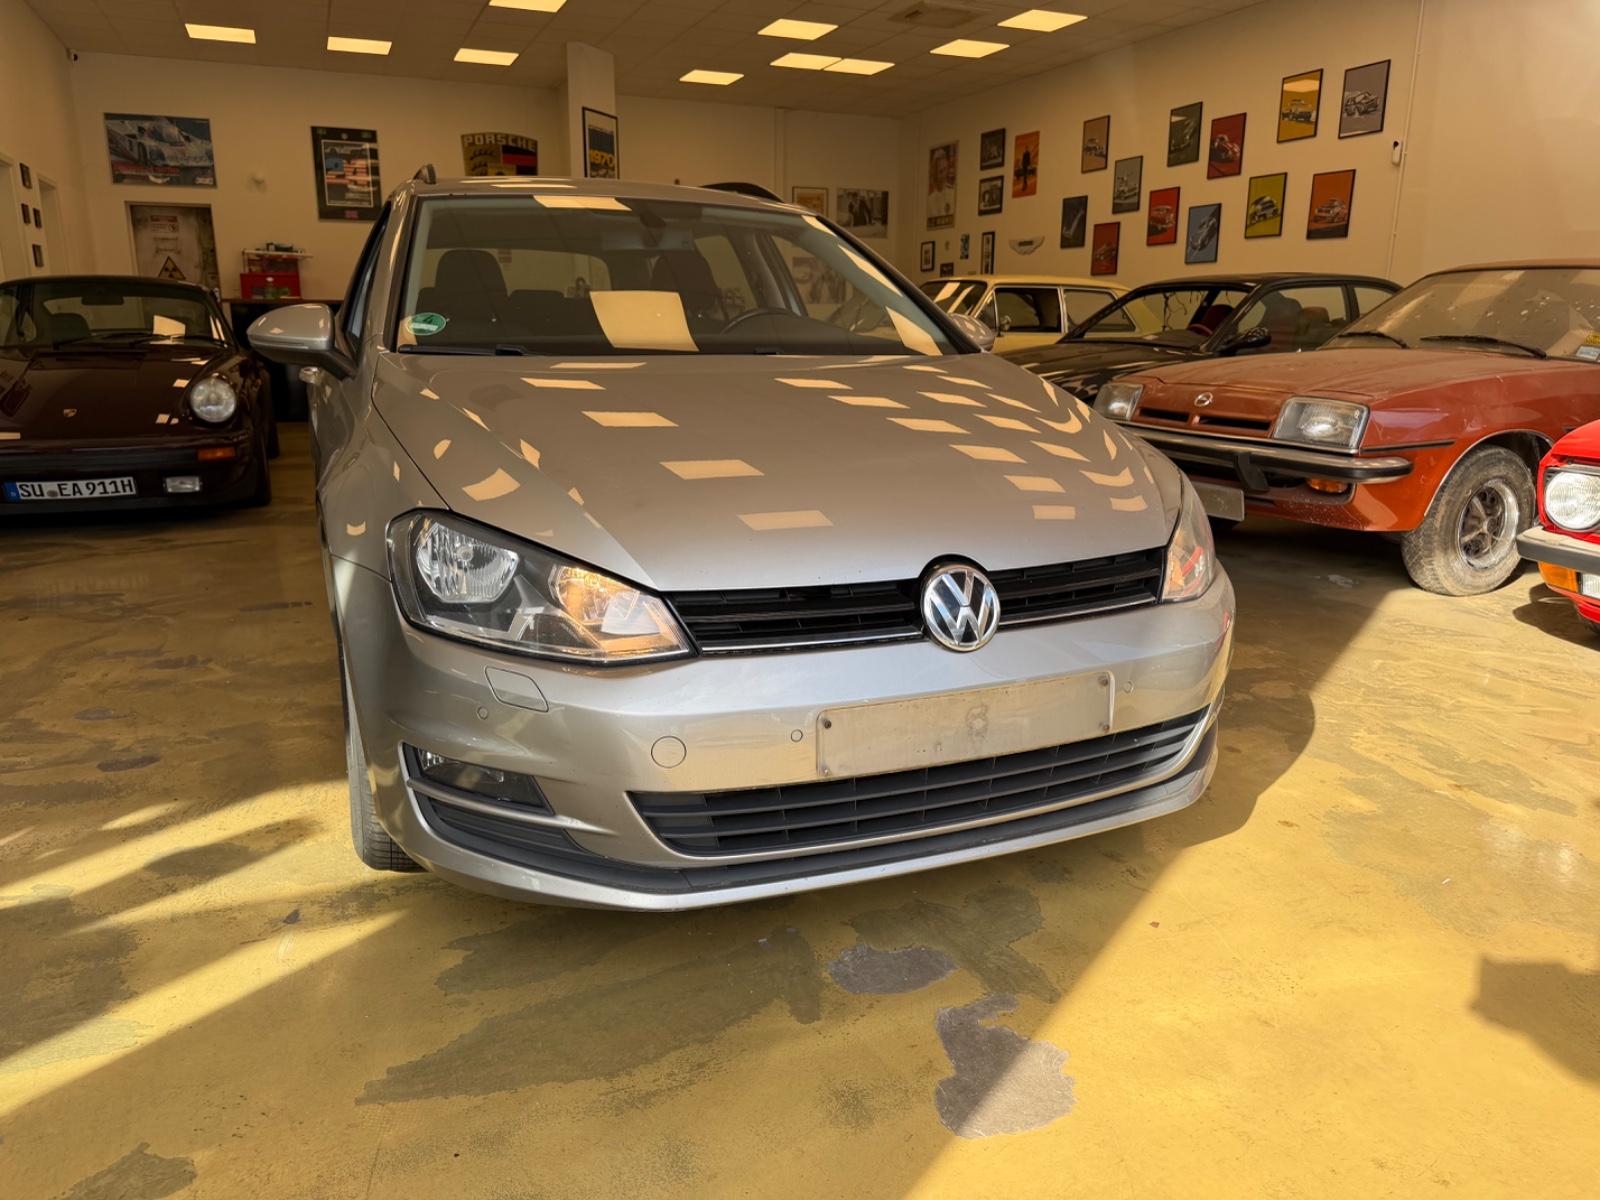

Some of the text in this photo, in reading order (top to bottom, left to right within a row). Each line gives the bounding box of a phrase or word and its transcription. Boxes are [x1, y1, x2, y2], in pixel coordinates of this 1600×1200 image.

[463, 133, 536, 152] PORSCHE
[19, 483, 45, 498] SU
[927, 567, 998, 649] VW
